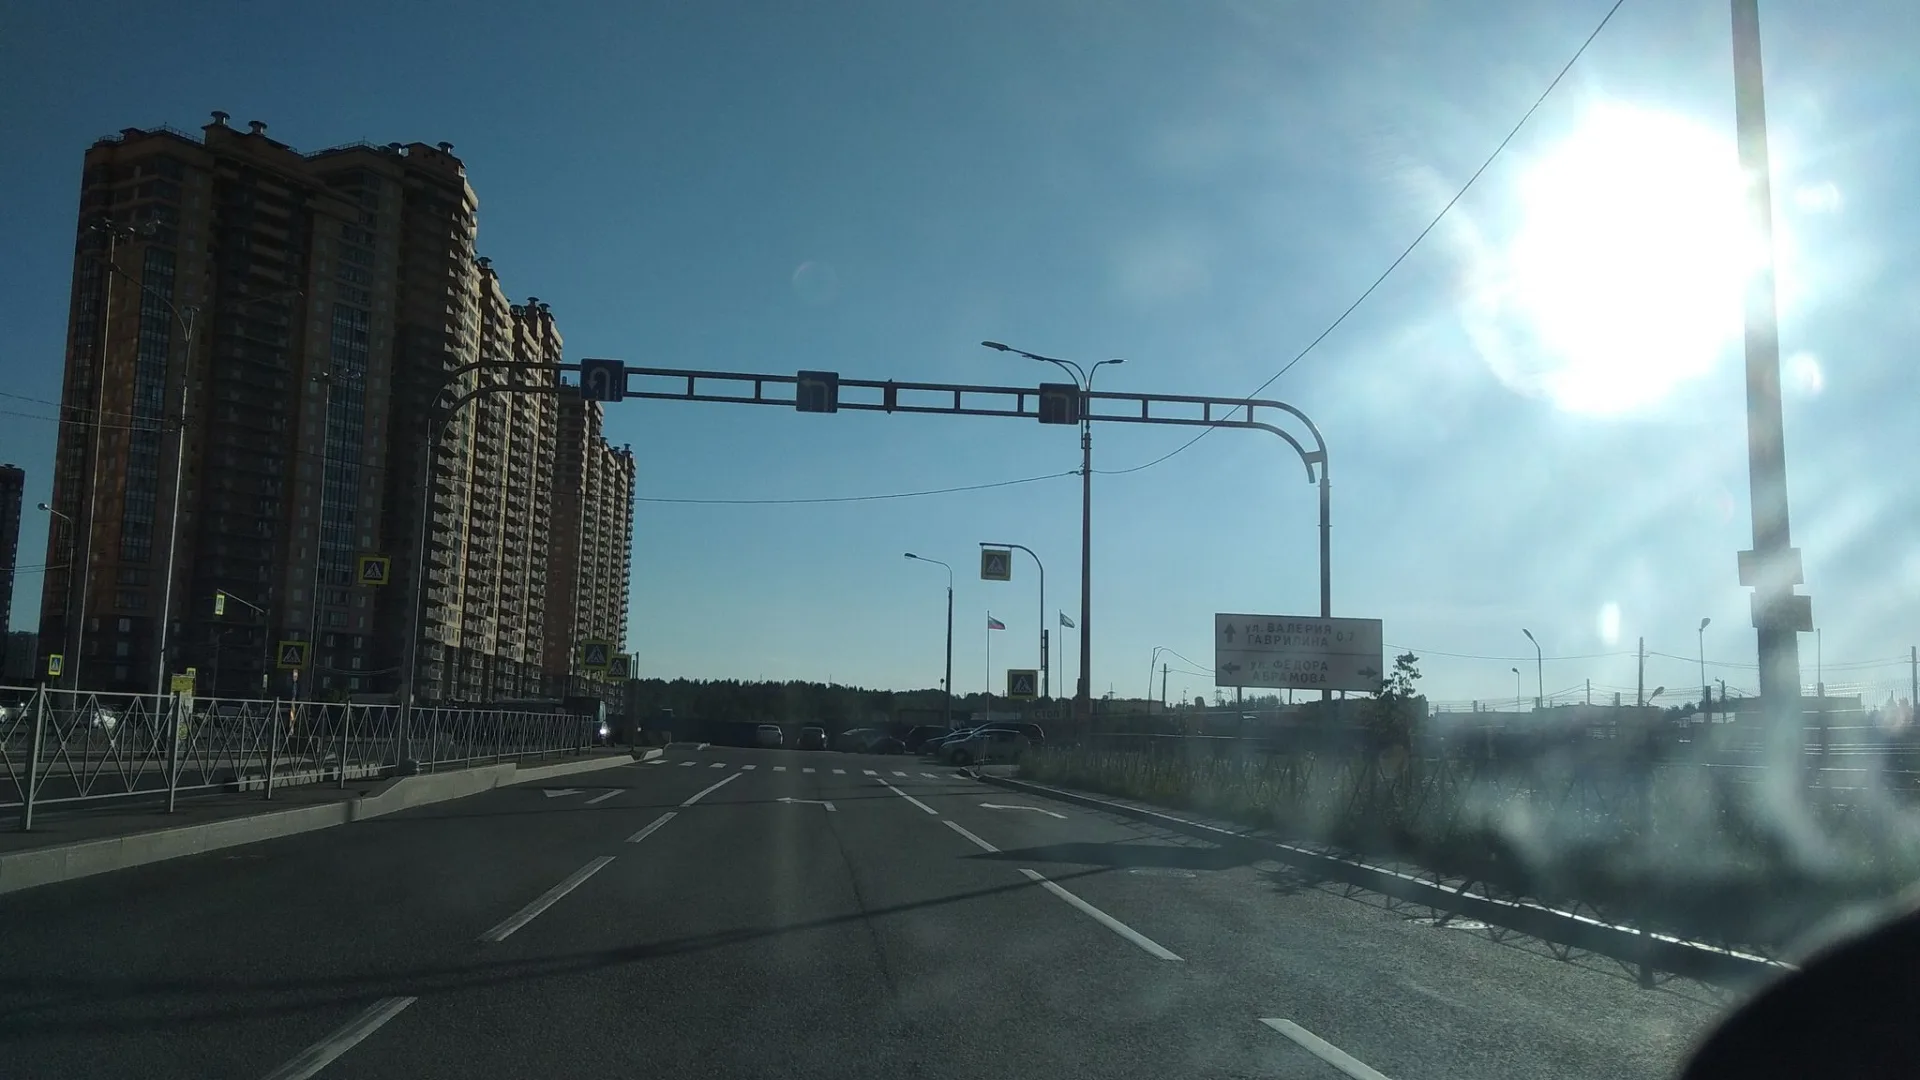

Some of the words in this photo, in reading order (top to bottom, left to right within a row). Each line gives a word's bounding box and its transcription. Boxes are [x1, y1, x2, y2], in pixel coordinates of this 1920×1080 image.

[1245, 624, 1264, 635] ул.
[1266, 623, 1332, 635] ВАЛЕРИЯ
[1247, 635, 1329, 647] ГАВРИЛИНА
[1253, 671, 1327, 683] АБРАМОВА
